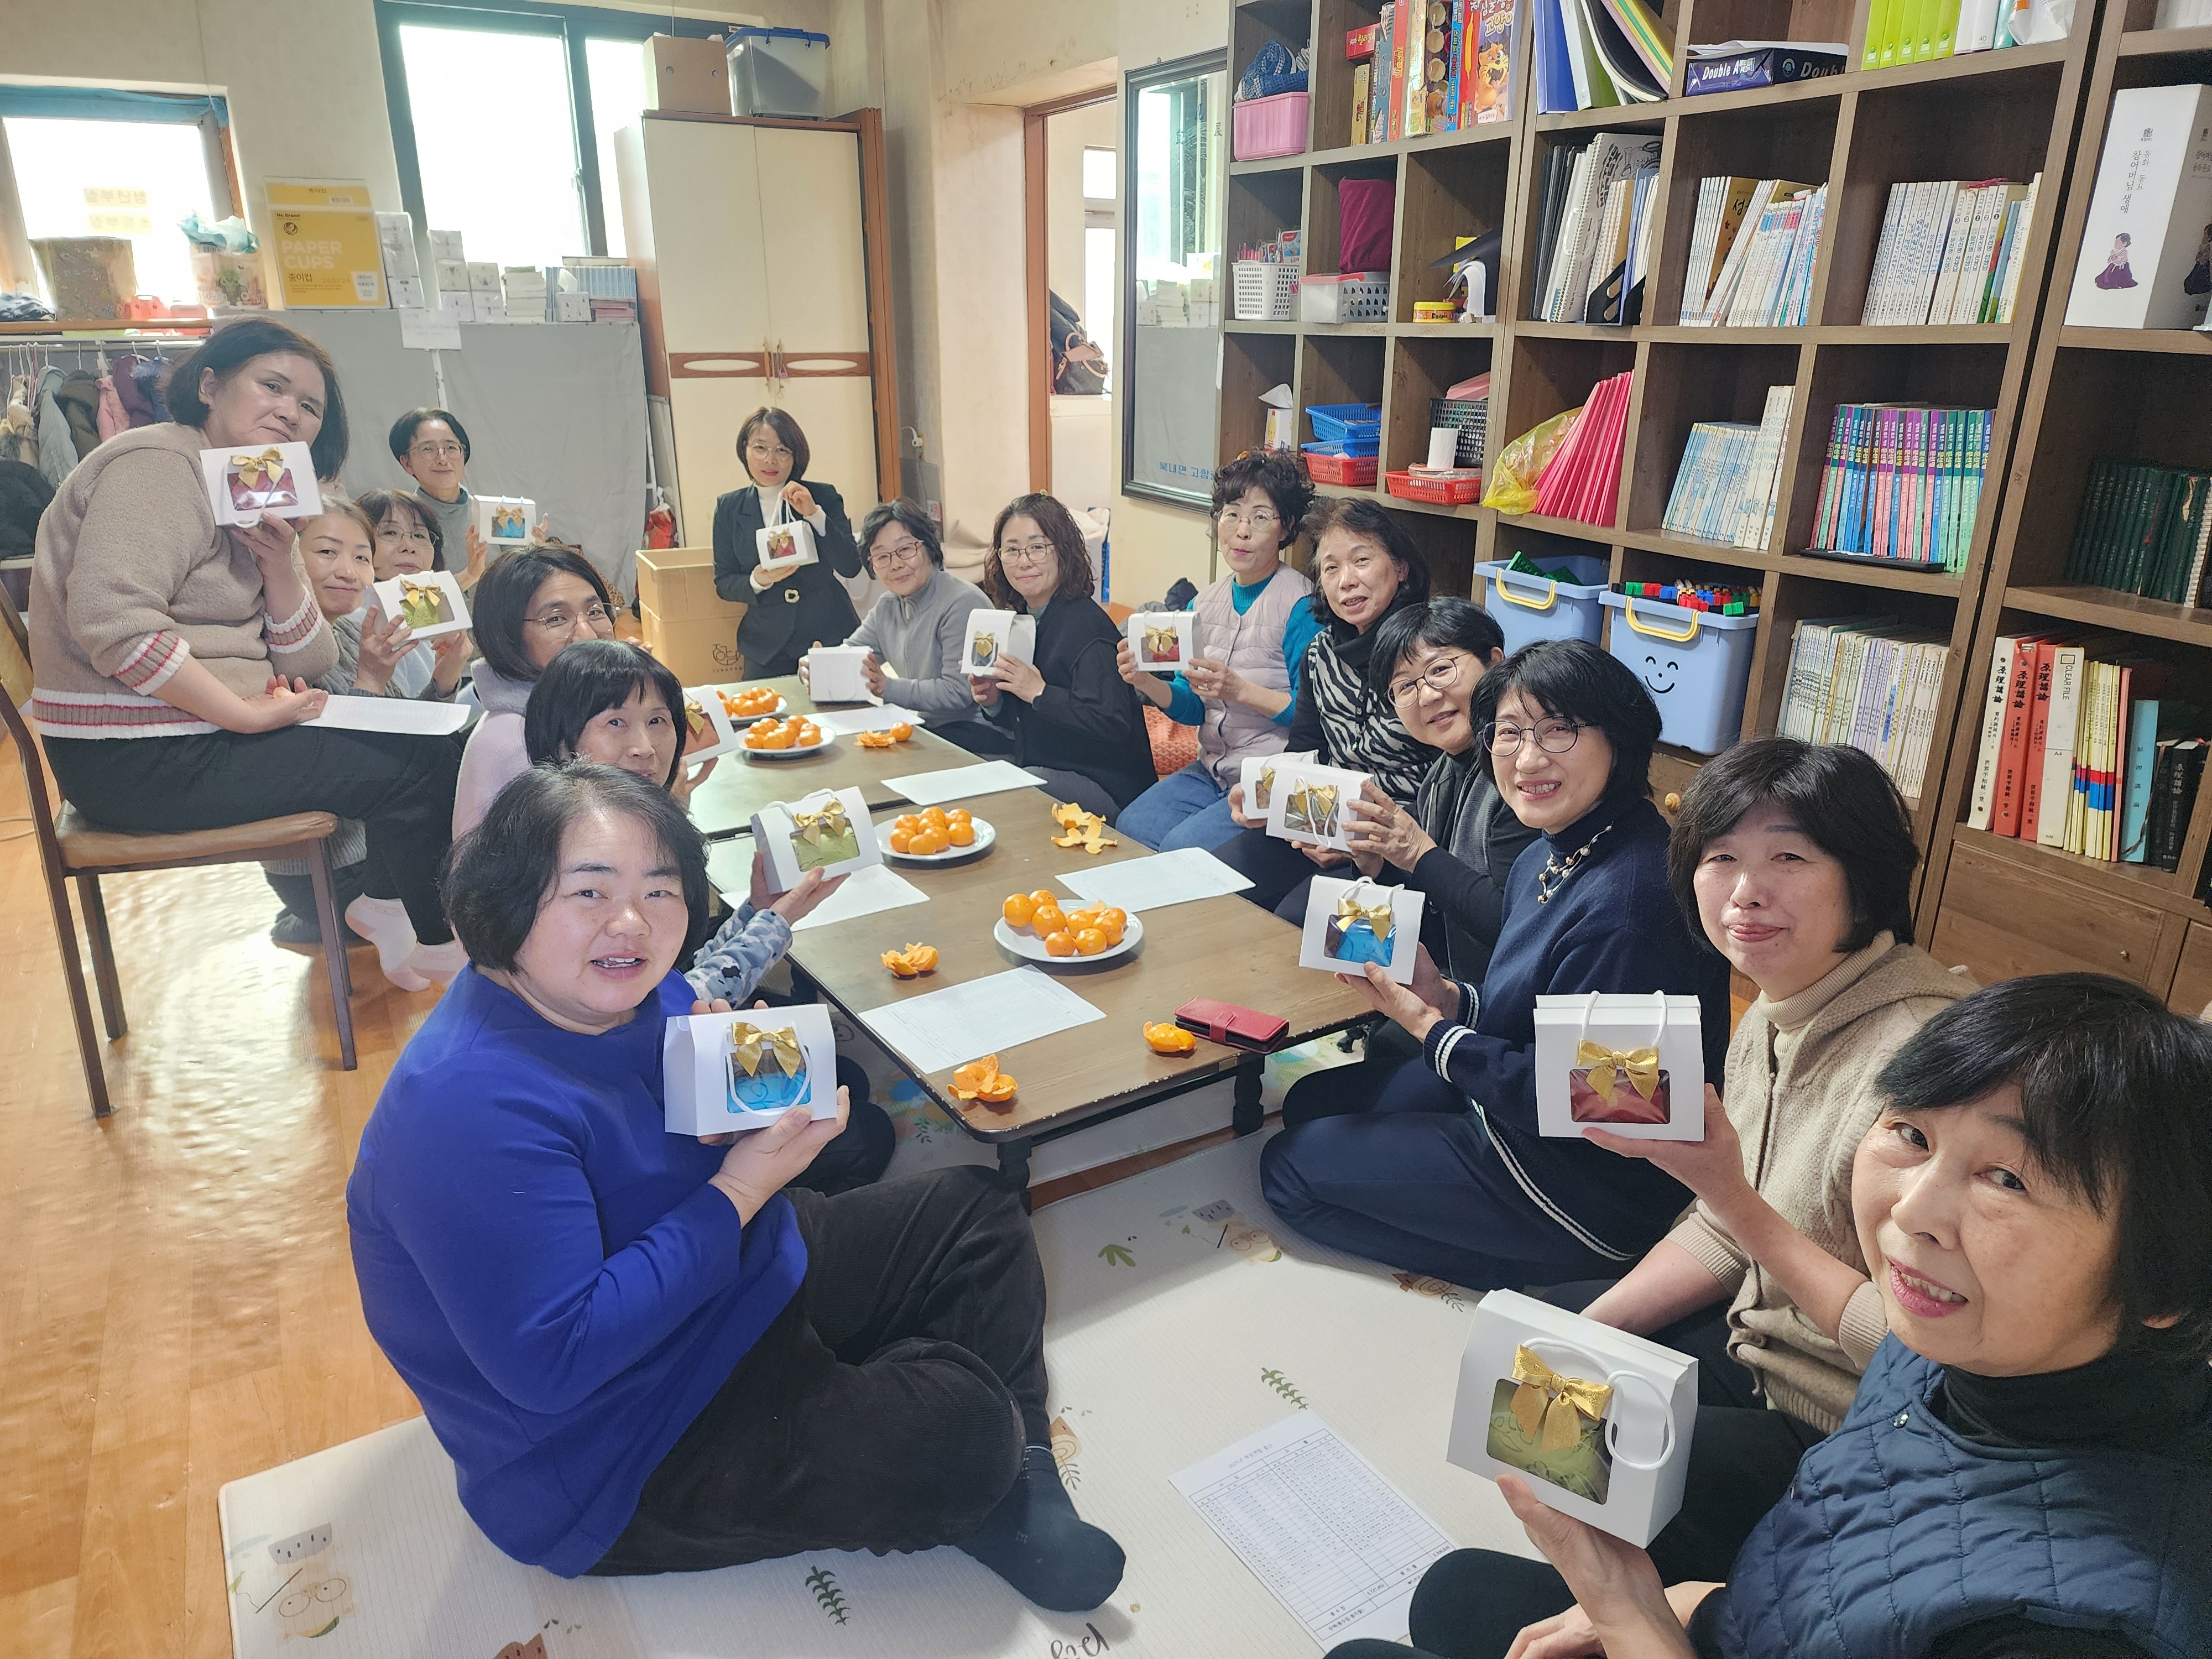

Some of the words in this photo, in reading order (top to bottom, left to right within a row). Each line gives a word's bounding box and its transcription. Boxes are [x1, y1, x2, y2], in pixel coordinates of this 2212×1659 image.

[1702, 61, 1731, 81] Double
[1732, 59, 1740, 76] A
[2141, 150, 2152, 167] 동화
[2126, 150, 2142, 191] 참어머님
[2136, 174, 2146, 190] 동요
[2120, 194, 2132, 214] 생애
[281, 240, 343, 254] PAPER
[284, 255, 335, 269] CUPS
[288, 273, 313, 283] 종이컵
[2063, 665, 2073, 688] CLEAR
[2062, 687, 2071, 701] FILE
